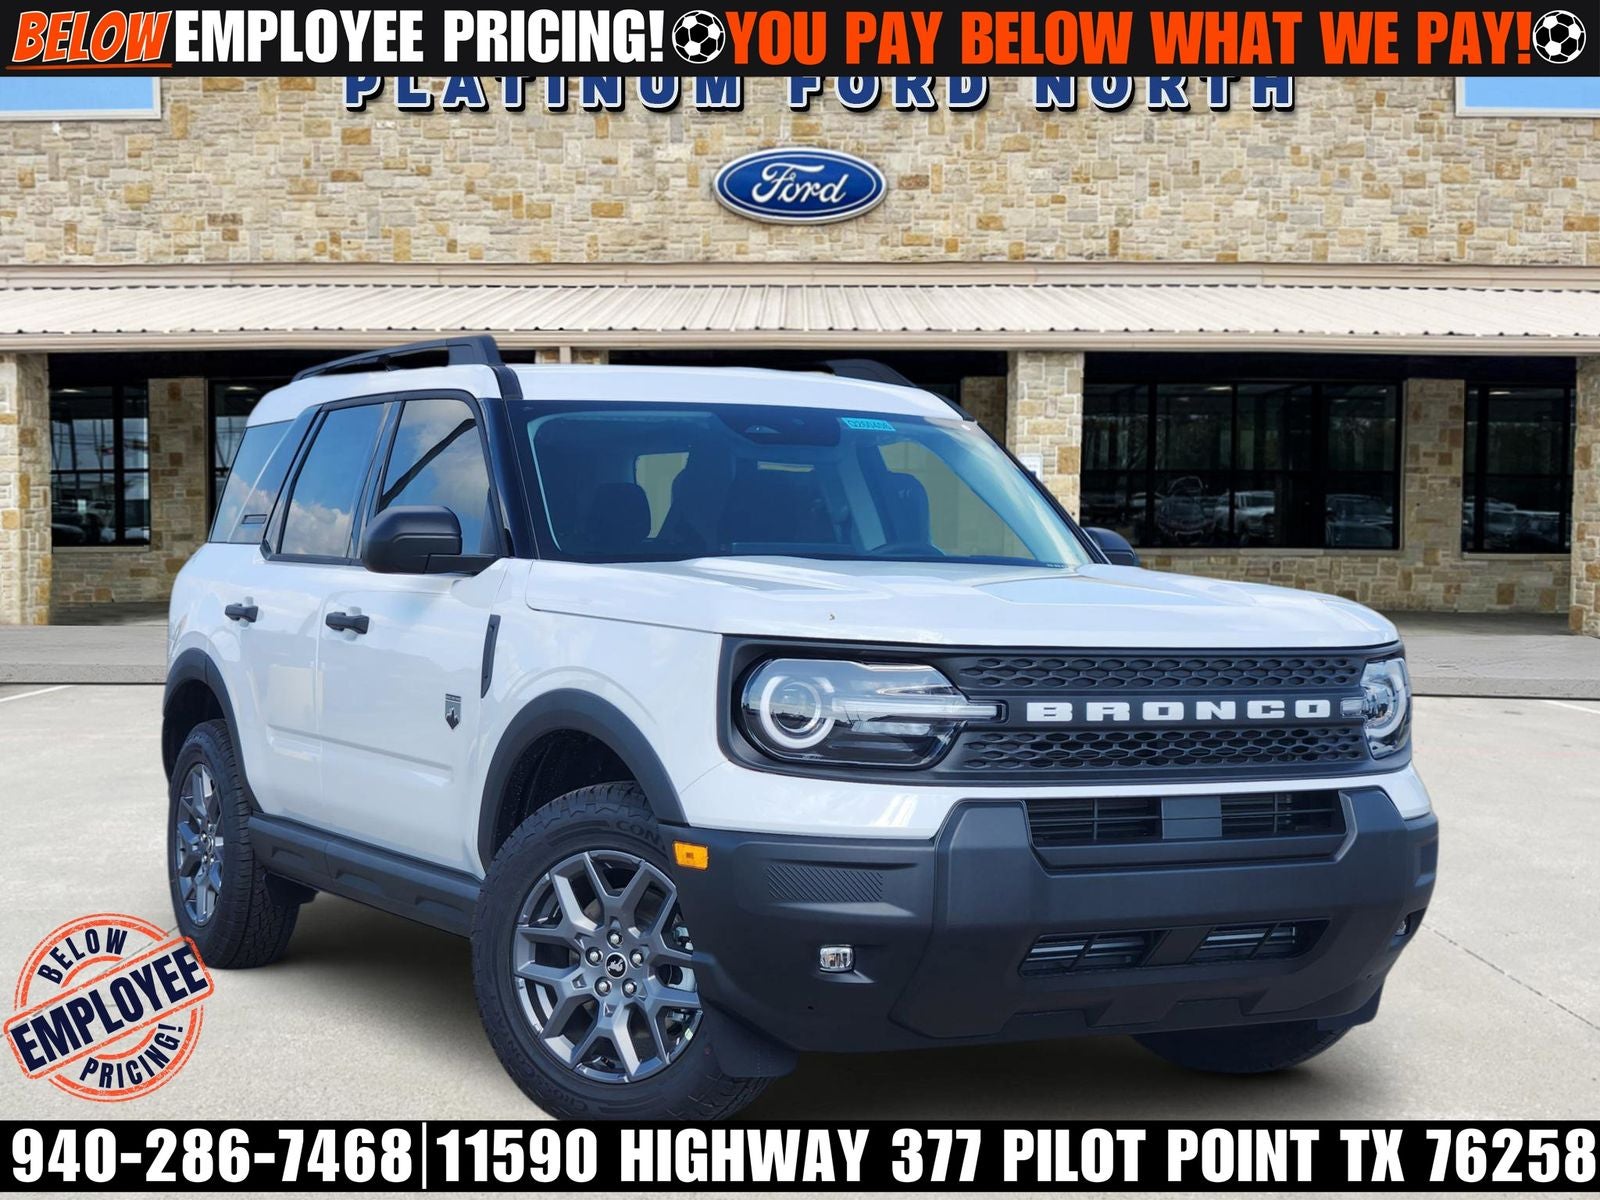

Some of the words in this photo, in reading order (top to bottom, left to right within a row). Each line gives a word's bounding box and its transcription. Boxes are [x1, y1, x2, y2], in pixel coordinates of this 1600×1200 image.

[342, 76, 743, 110] PLATINUM
[787, 76, 989, 110] FORD
[1033, 76, 1293, 110] NORTH
[752, 162, 849, 203] Ford
[1026, 699, 1331, 722] BRONCO
